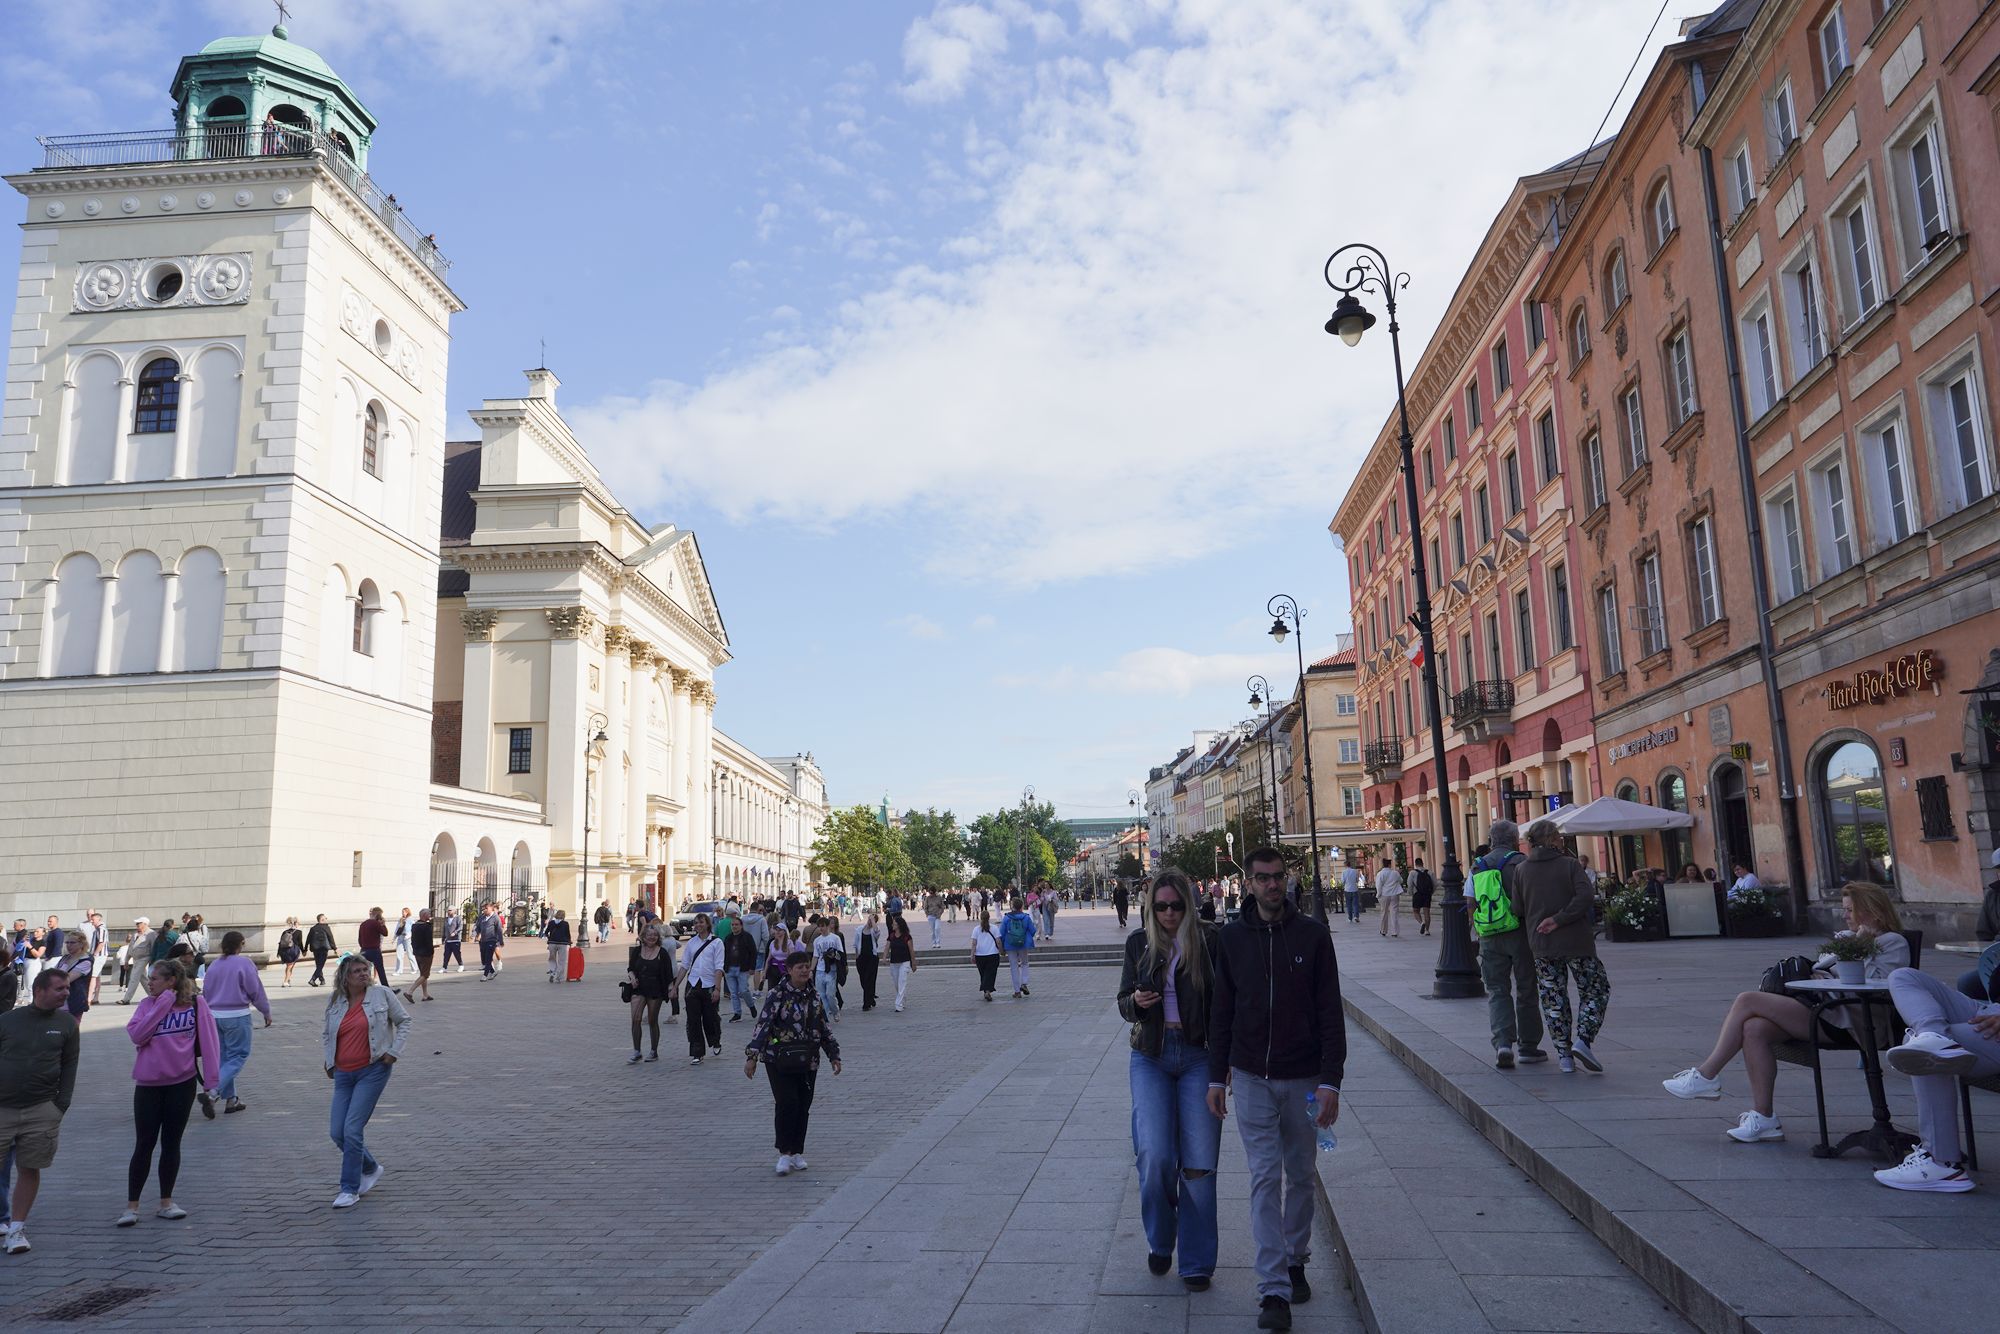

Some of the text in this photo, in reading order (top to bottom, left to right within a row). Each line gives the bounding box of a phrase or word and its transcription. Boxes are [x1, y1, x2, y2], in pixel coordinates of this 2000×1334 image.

[1827, 649, 1933, 711] Hard Rock Cafe
[1734, 745, 1745, 756] 81
